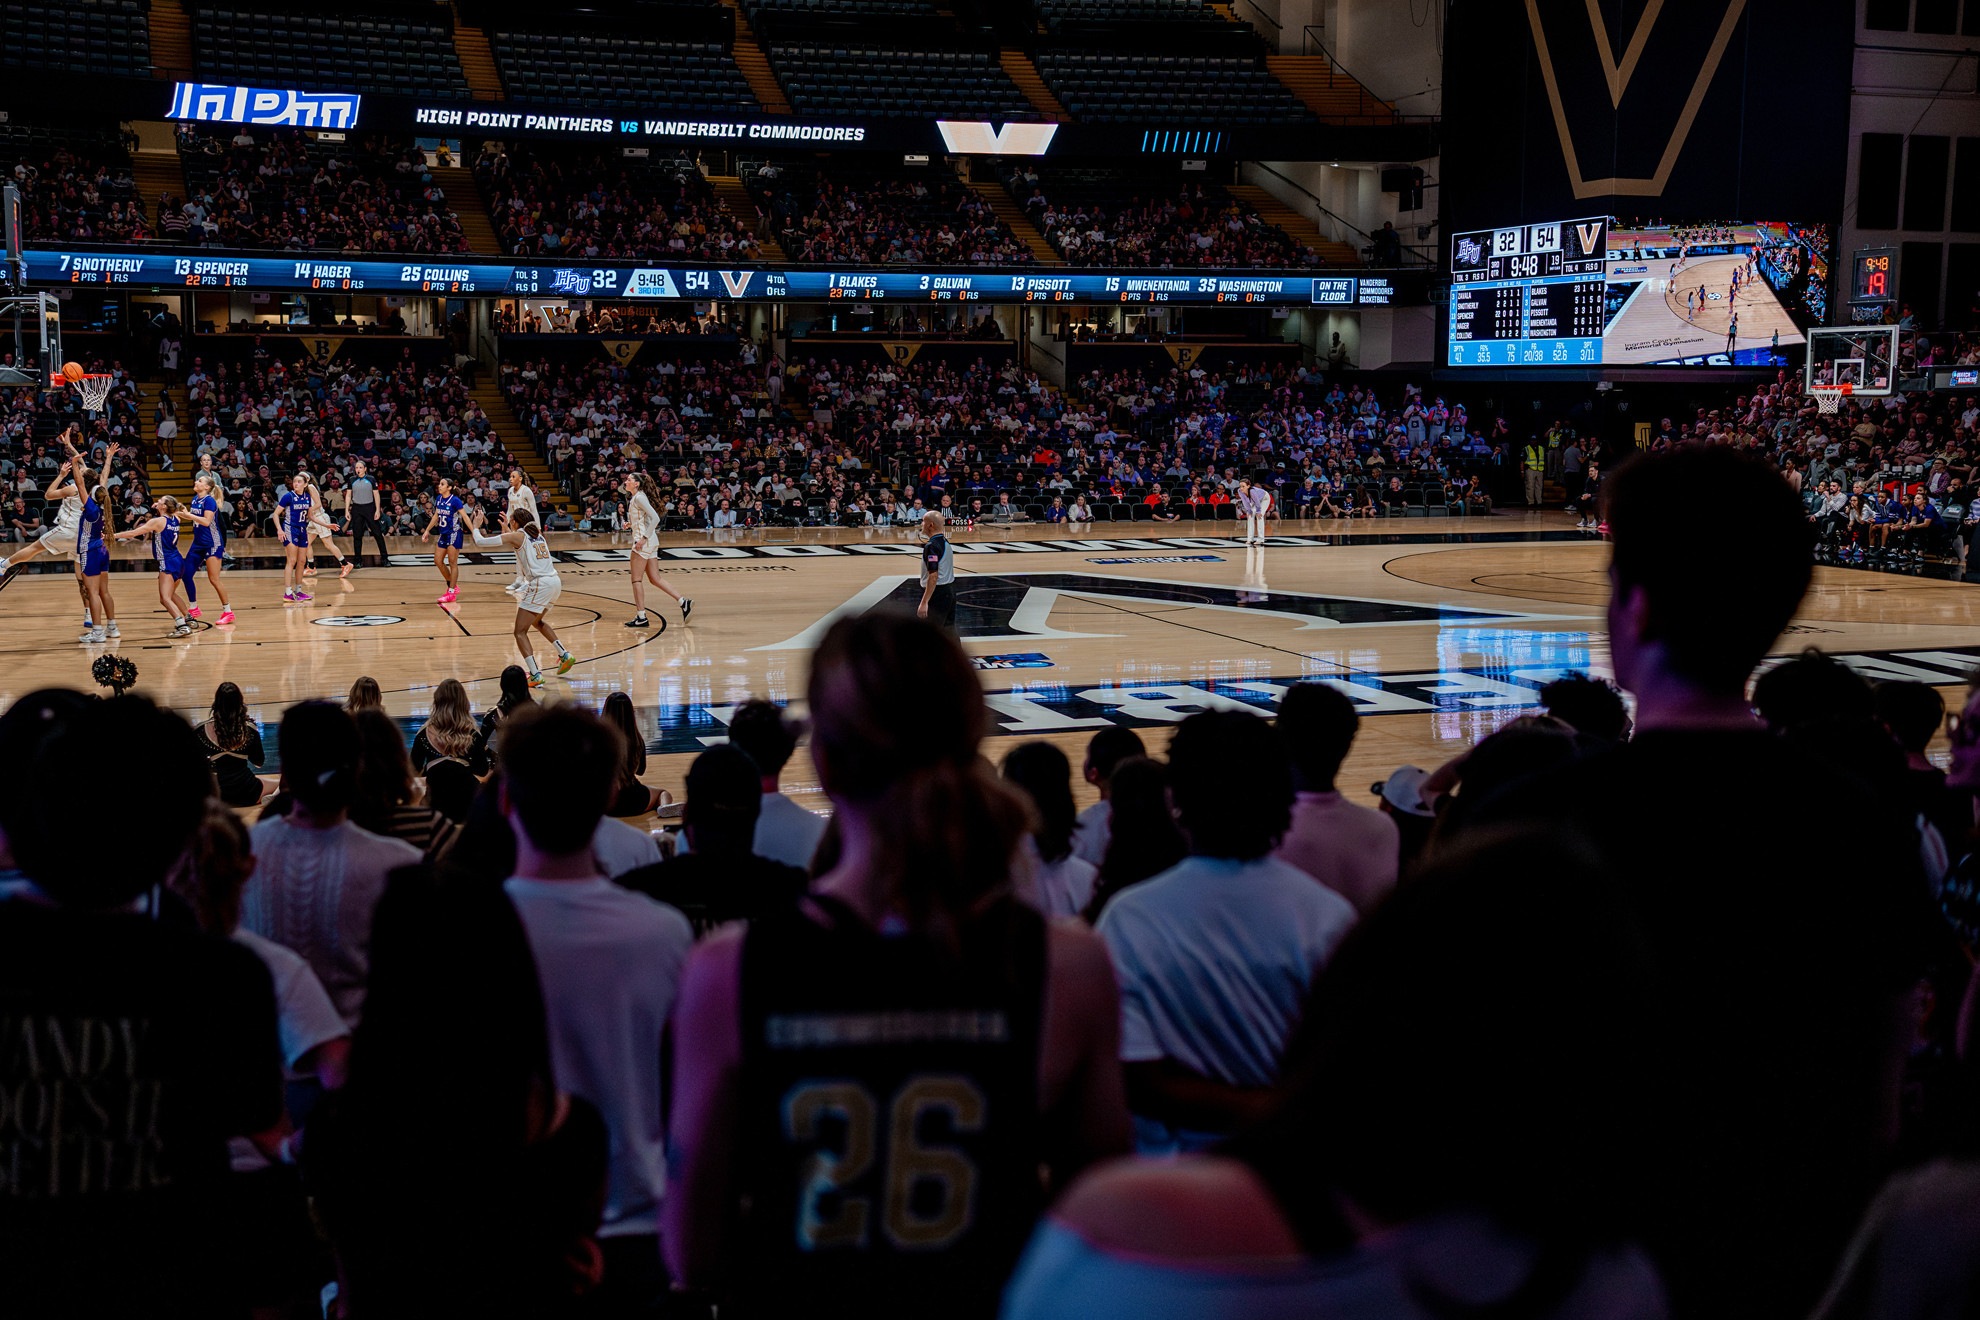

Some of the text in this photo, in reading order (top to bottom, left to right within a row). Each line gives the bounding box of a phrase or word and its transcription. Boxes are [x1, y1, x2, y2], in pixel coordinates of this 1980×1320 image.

[416, 109, 865, 141] HIGH POINT PANTHERS VS VANDERBILT COMMODORES
[1499, 232, 1515, 252] 32
[1537, 227, 1554, 249] 54
[60, 256, 144, 273] 7 SNOTHERLY
[1511, 256, 1538, 277] 9:48
[1551, 255, 1559, 265] 19
[1866, 257, 1888, 270] 9:48
[175, 259, 248, 276] 13 SPENCER
[294, 263, 352, 279] 14 HAGER
[401, 266, 469, 282] 25 COLLINS
[72, 272, 128, 283] 2 PTS 1 FLS
[186, 274, 247, 286] 22 PTS 1 FLS
[515, 270, 538, 279] TOL 3
[592, 270, 617, 289] 32
[638, 274, 665, 287] 9:48
[685, 272, 710, 290] 54
[766, 275, 786, 284] 4 TOL
[829, 274, 877, 288] 1 BLAKES
[312, 278, 364, 289] 0 PTS 0 FLS
[423, 281, 475, 292] 0 PTS 2 FLS
[515, 283, 538, 292] FLS 0
[920, 276, 971, 289] 3 GALVAN
[1011, 277, 1071, 291] 13 PISSOTT
[1106, 278, 1190, 292] 15 MWENENTANDA
[1198, 279, 1282, 292] 35 WASHINGTON
[1319, 281, 1347, 290] ON THE
[1868, 272, 1885, 295] 19
[766, 286, 786, 296] 0 FLS
[829, 289, 884, 299] 23 PTS 1 FLS
[930, 290, 978, 300] 5 PTS 0 FLS
[1026, 291, 1074, 301] 3 PTS 0 FLS
[1121, 292, 1168, 302] 6 PTS 1 FLS
[1321, 292, 1346, 301] FLOOR
[1531, 288, 1547, 296] BLAKES
[1217, 293, 1265, 303] 6 PTS 0 FLS
[314, 340, 330, 354] B
[616, 344, 630, 358] C
[894, 346, 908, 360] D
[1177, 348, 1192, 362] E
[1455, 353, 1462, 362] 41
[1477, 352, 1490, 362] 35.5
[1508, 352, 1515, 362] 75
[1524, 351, 1543, 361] 20/38
[1553, 350, 1567, 361] 52.6
[1580, 350, 1595, 361] 3/11
[533, 542, 549, 560] 15
[779, 1071, 990, 1253] 26
